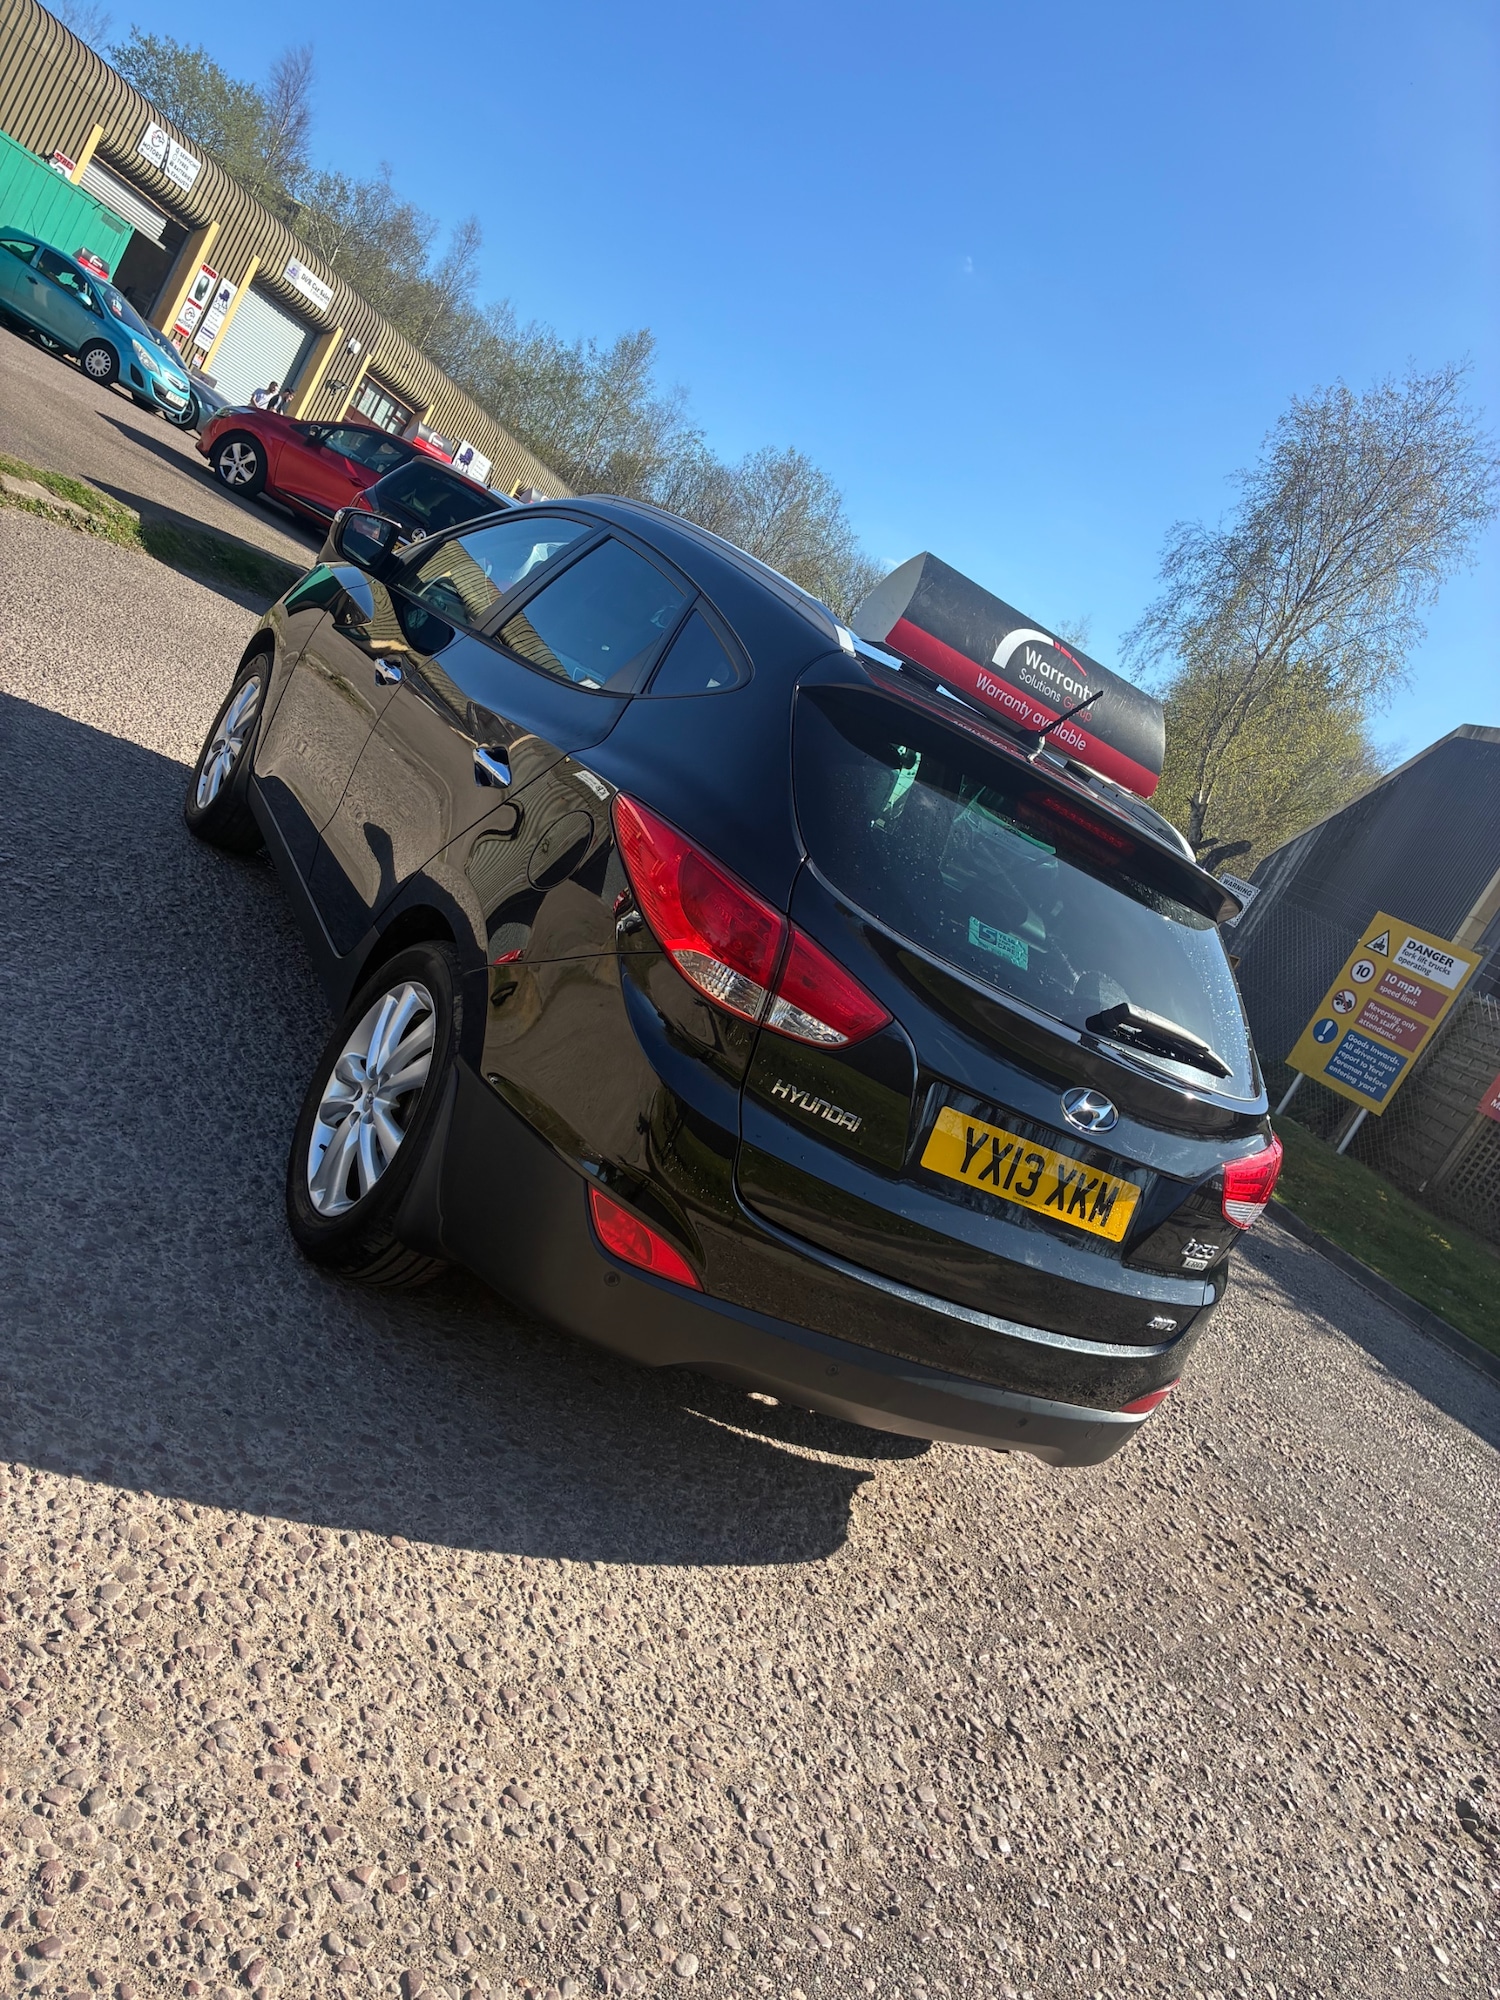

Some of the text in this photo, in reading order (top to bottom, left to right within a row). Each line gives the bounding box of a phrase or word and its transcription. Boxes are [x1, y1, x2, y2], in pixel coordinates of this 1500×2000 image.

[142, 141, 162, 160] MOTORS
[180, 151, 199, 171] SERVICING
[174, 164, 193, 183] BATTERIES
[177, 158, 189, 171] TYRES
[170, 170, 190, 189] EXHAUSTS
[311, 282, 320, 293] Car
[320, 290, 330, 302] Sales
[976, 673, 1033, 720] Warranty
[1019, 667, 1092, 723] Solutions Grup
[1223, 879, 1253, 897] WARNING
[1398, 956, 1432, 976] operating
[1402, 948, 1452, 976] fork lift trucks
[1406, 940, 1455, 968] DANGER
[1355, 964, 1371, 978] 10
[1380, 985, 1418, 1007] speed limit
[1385, 973, 1422, 997] 10 mph
[1364, 1010, 1403, 1034] with staff in
[1368, 1002, 1417, 1032] Reversing only
[1358, 1018, 1397, 1041] attendance
[1343, 1042, 1396, 1073] All drivers must
[1348, 1034, 1400, 1066] Goods Inwards.
[1333, 1056, 1388, 1089] Foreman before
[1338, 1050, 1385, 1077] report to Yard
[1329, 1065, 1377, 1093] entering yard
[771, 1079, 862, 1133] HYUNDAI
[960, 1126, 1120, 1228] YX13 XKM
[1181, 1238, 1220, 1259] ix35
[1146, 1316, 1178, 1332] 4WD
